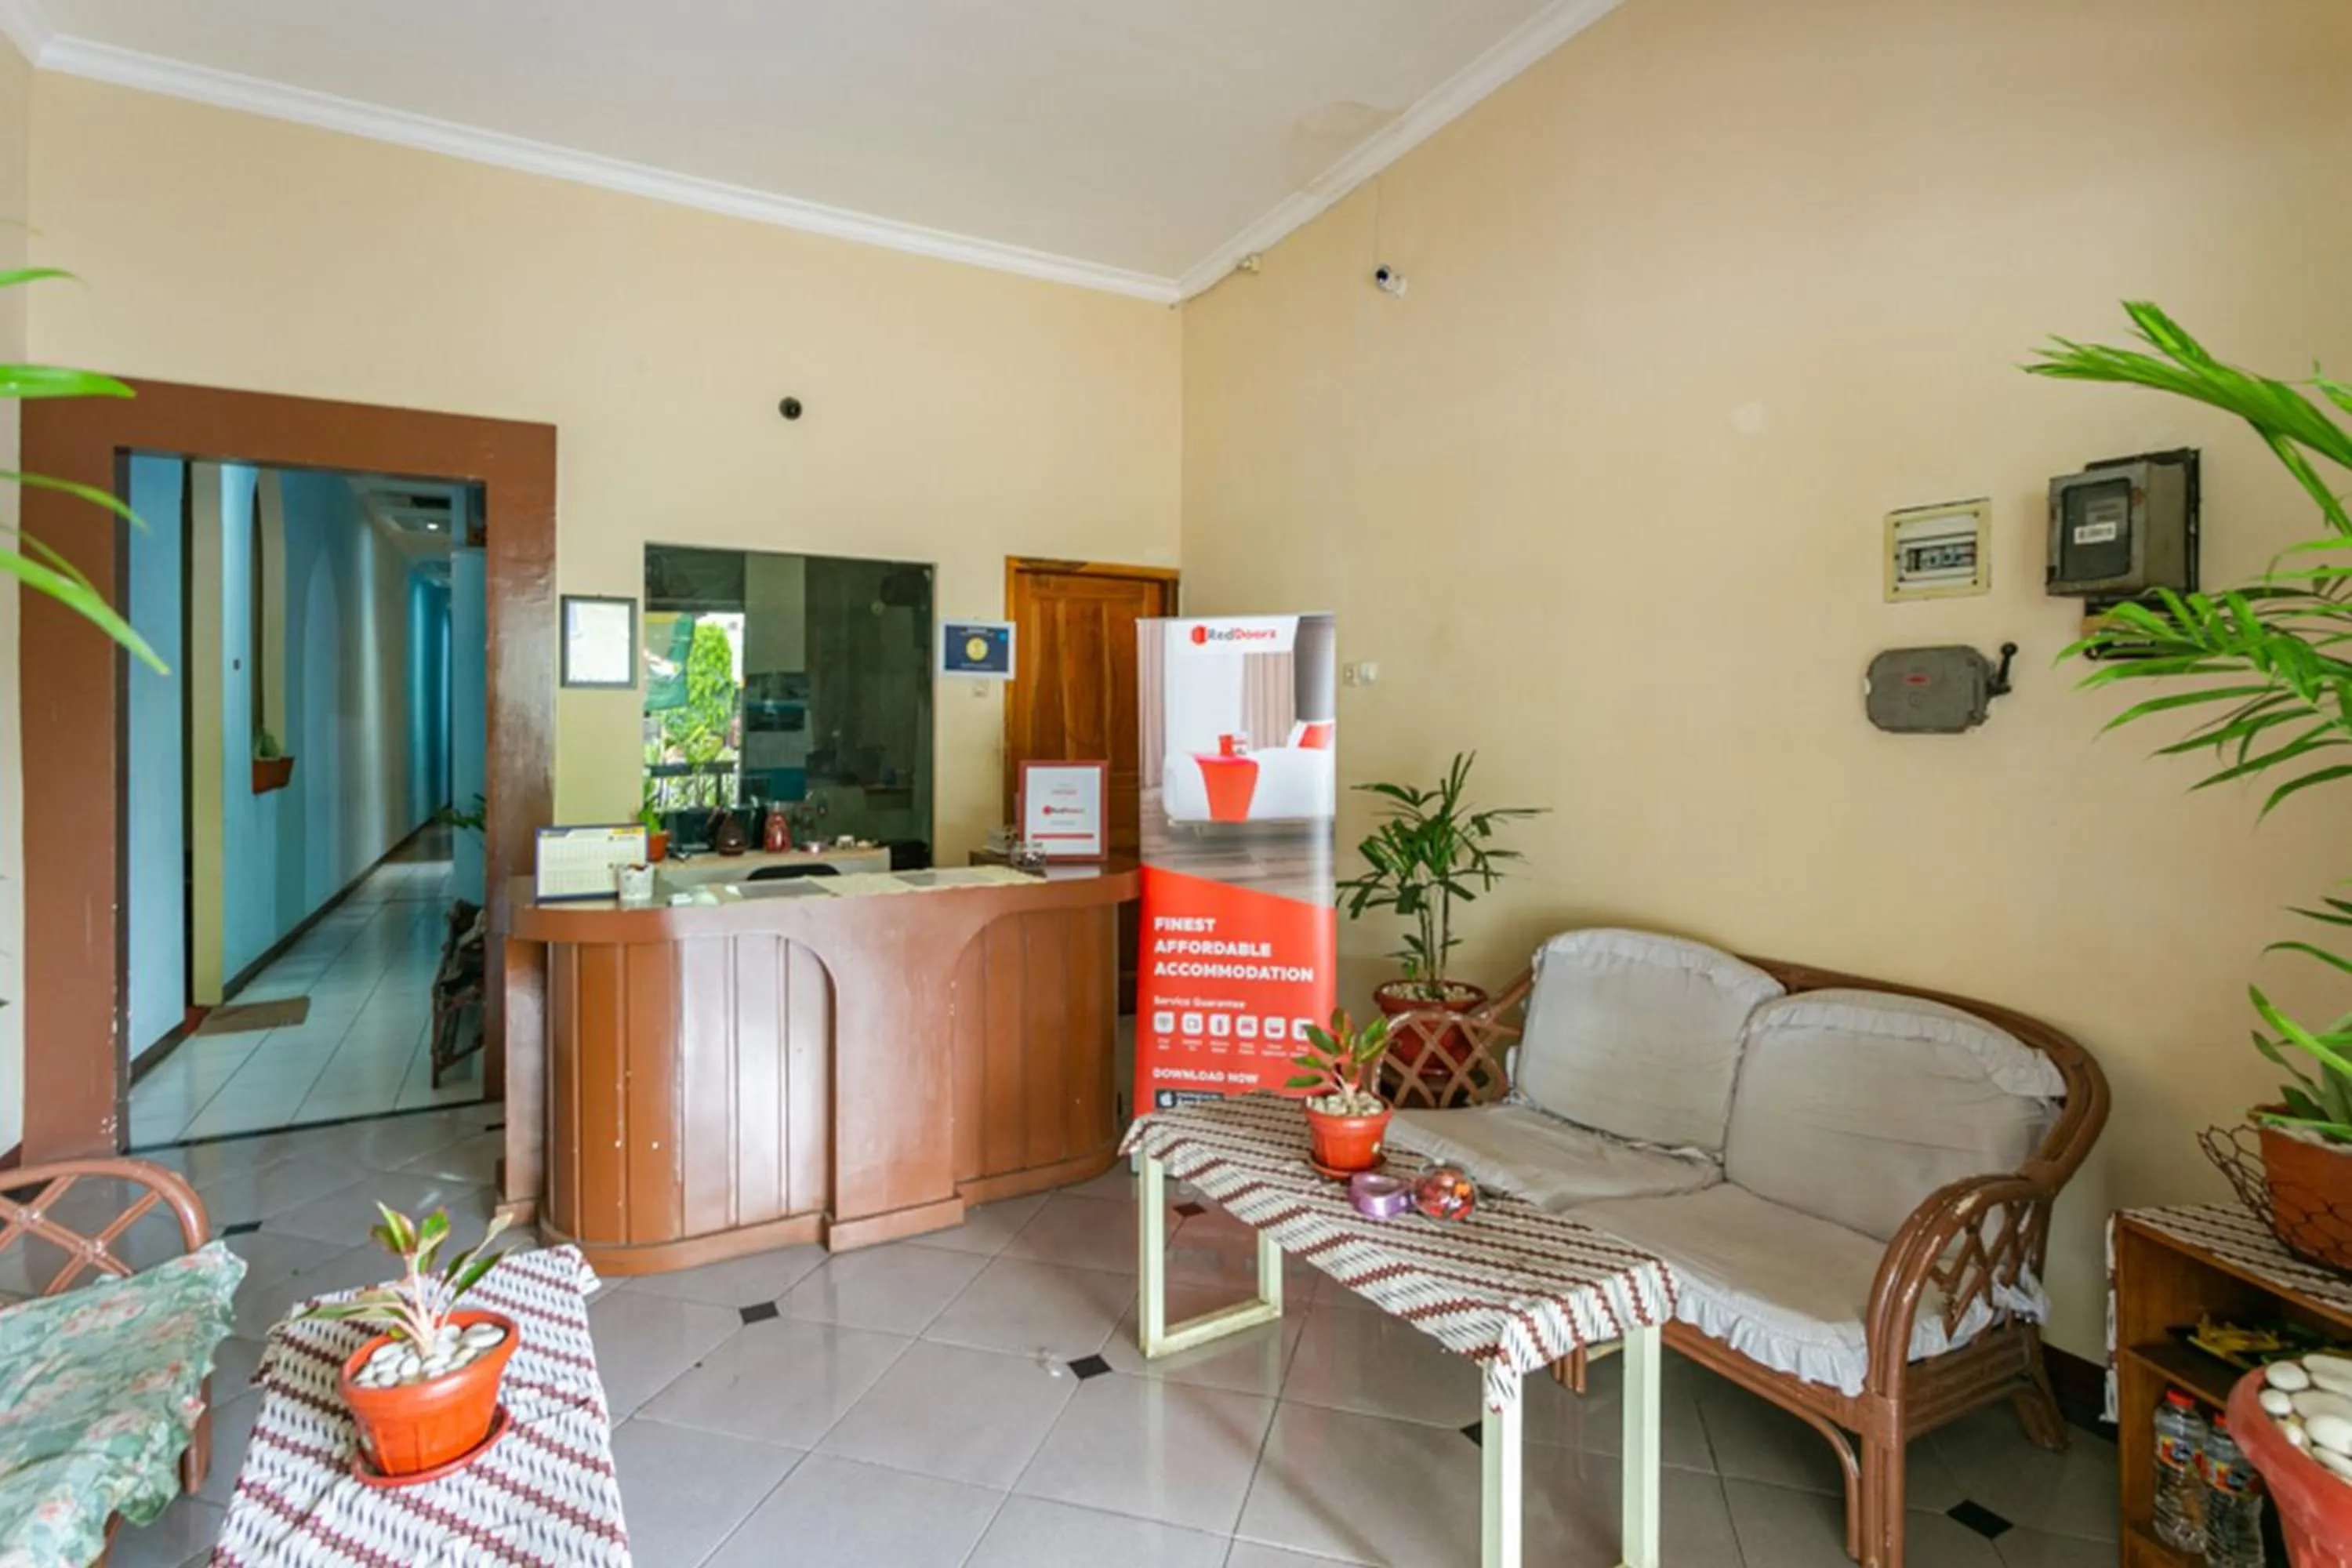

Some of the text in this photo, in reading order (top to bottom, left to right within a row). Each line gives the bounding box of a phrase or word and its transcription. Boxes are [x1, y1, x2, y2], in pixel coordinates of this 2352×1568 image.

[1154, 916, 1216, 932] FINEST
[1154, 939, 1272, 957] AFFORDABLE
[1155, 962, 1314, 982] ACCOMMODATION
[1153, 996, 1245, 1009] Service Guarantee
[1152, 1067, 1259, 1083] DOWNLOAD NOW
